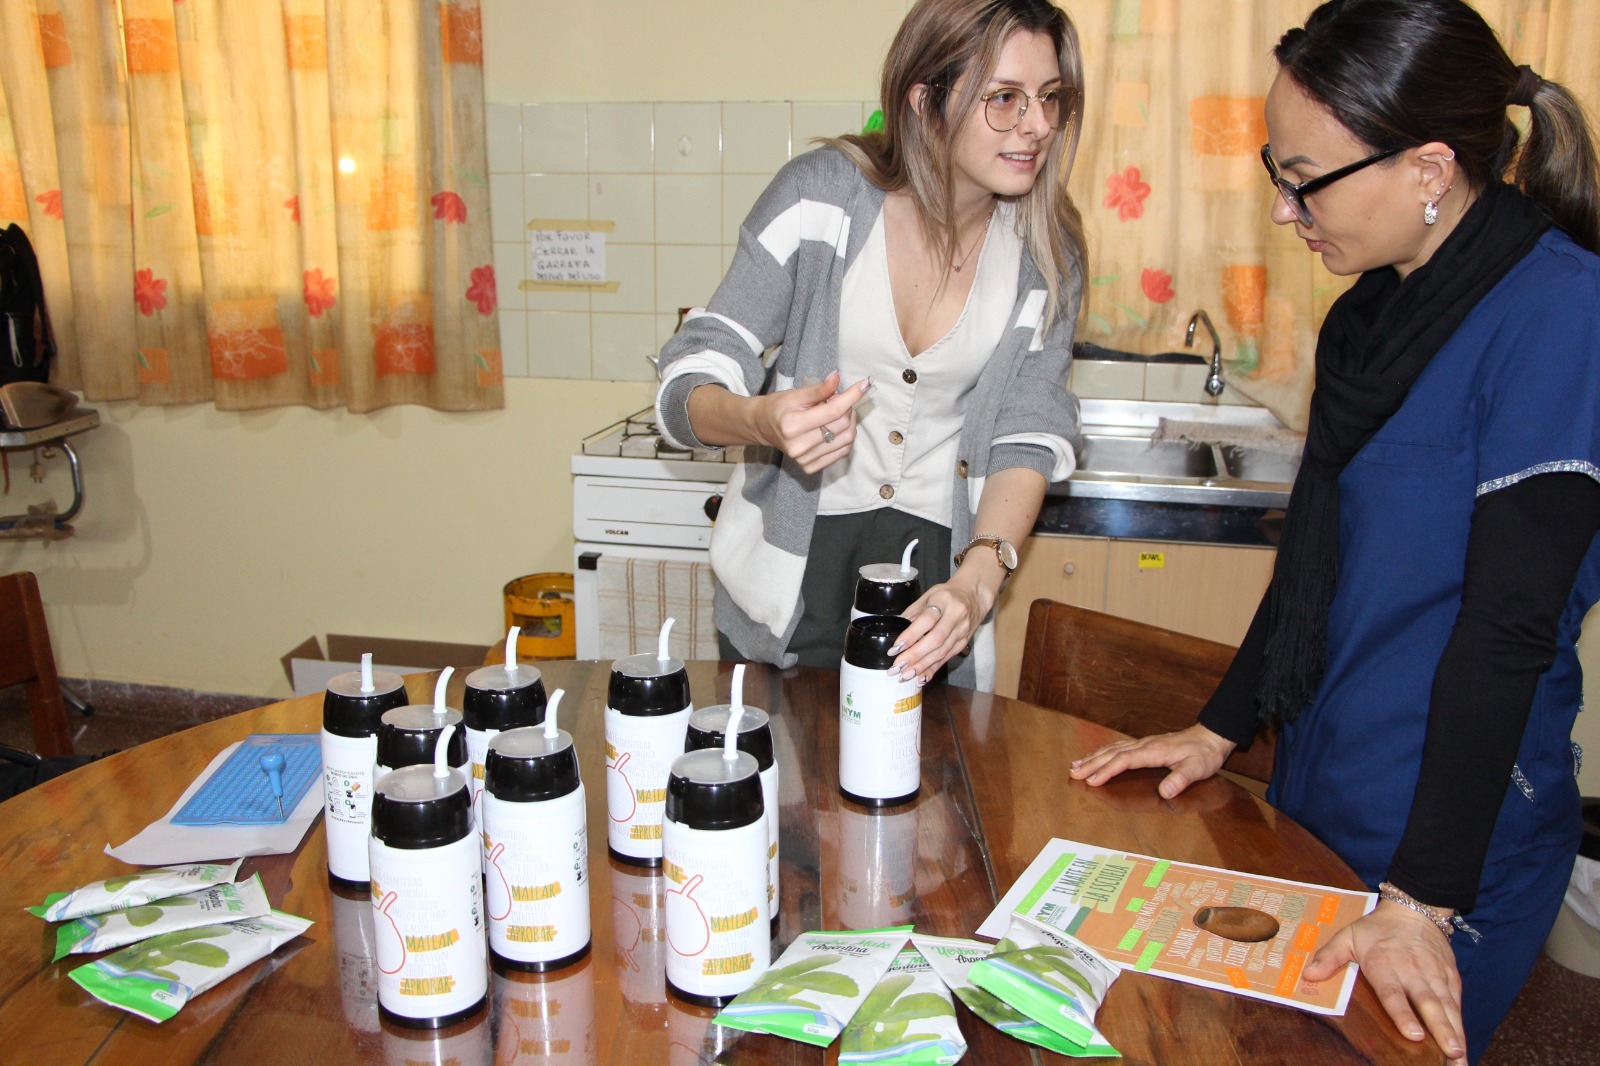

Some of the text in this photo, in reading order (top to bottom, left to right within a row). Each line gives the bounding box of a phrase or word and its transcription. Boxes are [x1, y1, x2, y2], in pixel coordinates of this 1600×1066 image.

[636, 788, 667, 802] MATEA
[1072, 857, 1099, 870] EN
[1059, 868, 1091, 887] MATE
[1082, 864, 1130, 902] LA ESCUELA
[511, 884, 556, 900] MATEAR
[1052, 886, 1079, 896] EL
[710, 911, 754, 931] MATEAR
[405, 932, 453, 951] MATEAR
[510, 925, 553, 942] APROBAR
[811, 943, 869, 953] Argentina
[931, 946, 978, 957] Yerba
[707, 953, 752, 974] APROBAR
[404, 977, 452, 995] APROBAR
